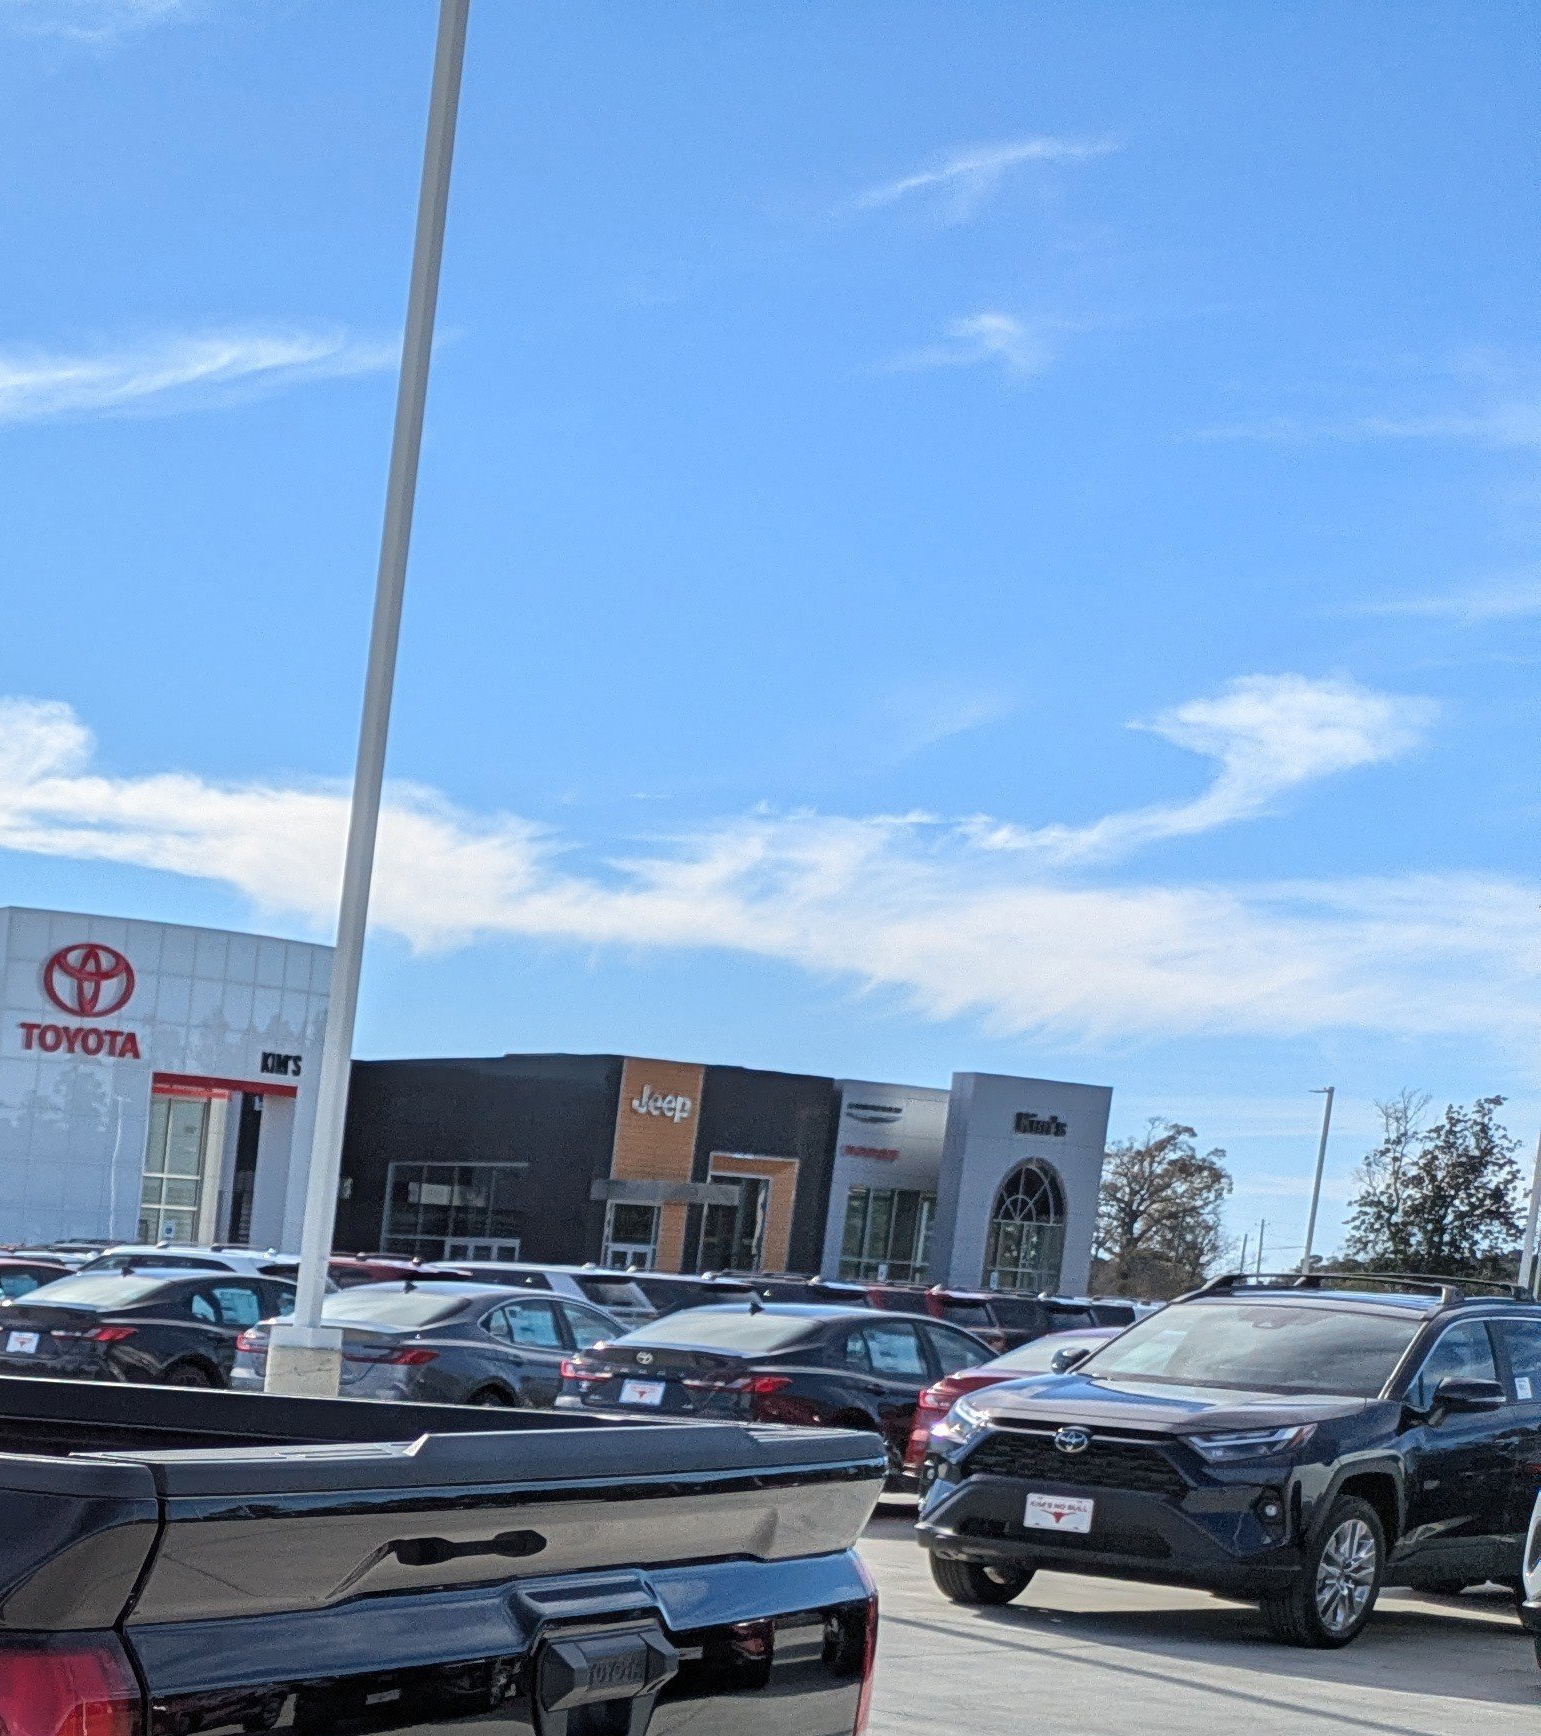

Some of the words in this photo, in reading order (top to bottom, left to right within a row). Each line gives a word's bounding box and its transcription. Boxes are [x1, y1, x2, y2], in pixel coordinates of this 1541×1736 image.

[19, 1022, 141, 1060] TOYOTA
[260, 1051, 302, 1076] KIM'S
[631, 1083, 692, 1124] Jeep
